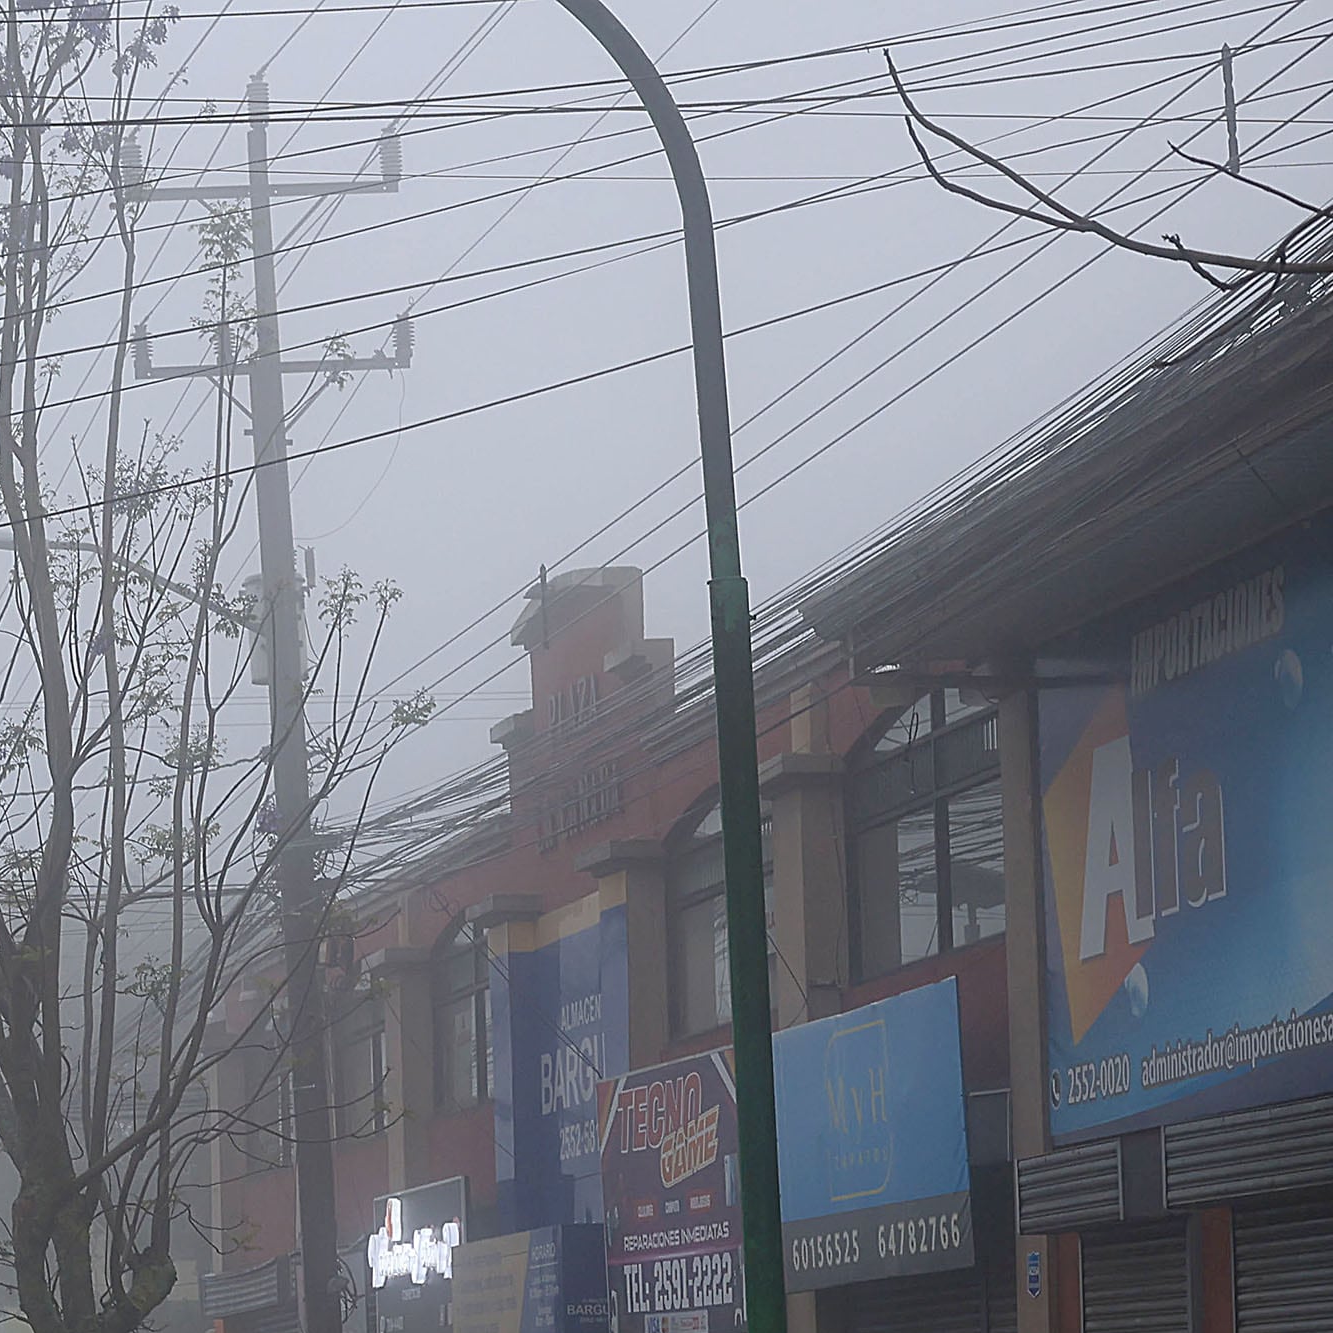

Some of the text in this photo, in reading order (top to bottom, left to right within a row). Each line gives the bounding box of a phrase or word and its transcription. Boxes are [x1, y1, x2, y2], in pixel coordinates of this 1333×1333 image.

[1130, 564, 1285, 698] IMPORTACIONES
[1079, 735, 1228, 961] Alfa
[560, 994, 603, 1031] ALMACEN
[1067, 1052, 1130, 1105] 2552-0020
[618, 1071, 703, 1155] TECNO
[659, 1103, 721, 1189] GAME
[623, 1219, 730, 1253] REPARACIONES INMEDIATAS
[792, 1212, 961, 1272] 60156525 64782766
[623, 1251, 733, 1313] TEL: 2591-2222
